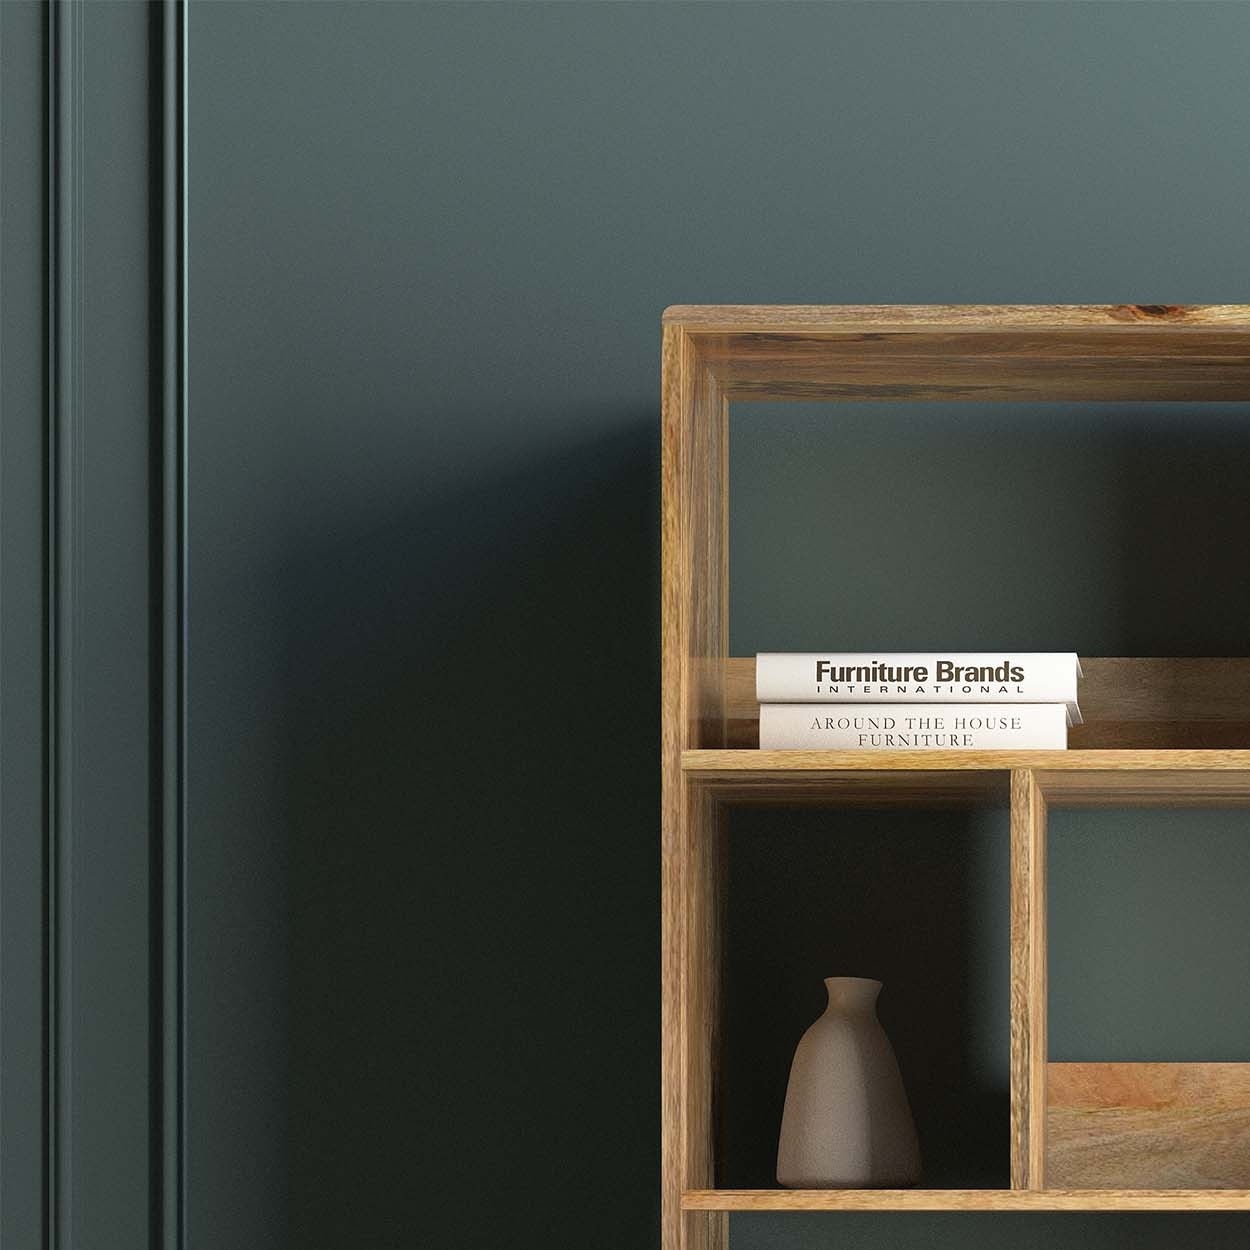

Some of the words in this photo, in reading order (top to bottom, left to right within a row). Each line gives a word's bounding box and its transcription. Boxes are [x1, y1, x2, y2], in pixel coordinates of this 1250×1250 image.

[816, 660, 928, 683] Furniture
[936, 660, 1025, 683] Brands
[816, 685, 1025, 694] INTERNATIONAL
[811, 717, 896, 730] AROUND
[905, 717, 945, 730] THE
[954, 717, 1022, 730] HOUSE
[858, 734, 974, 747] FURNITURE
